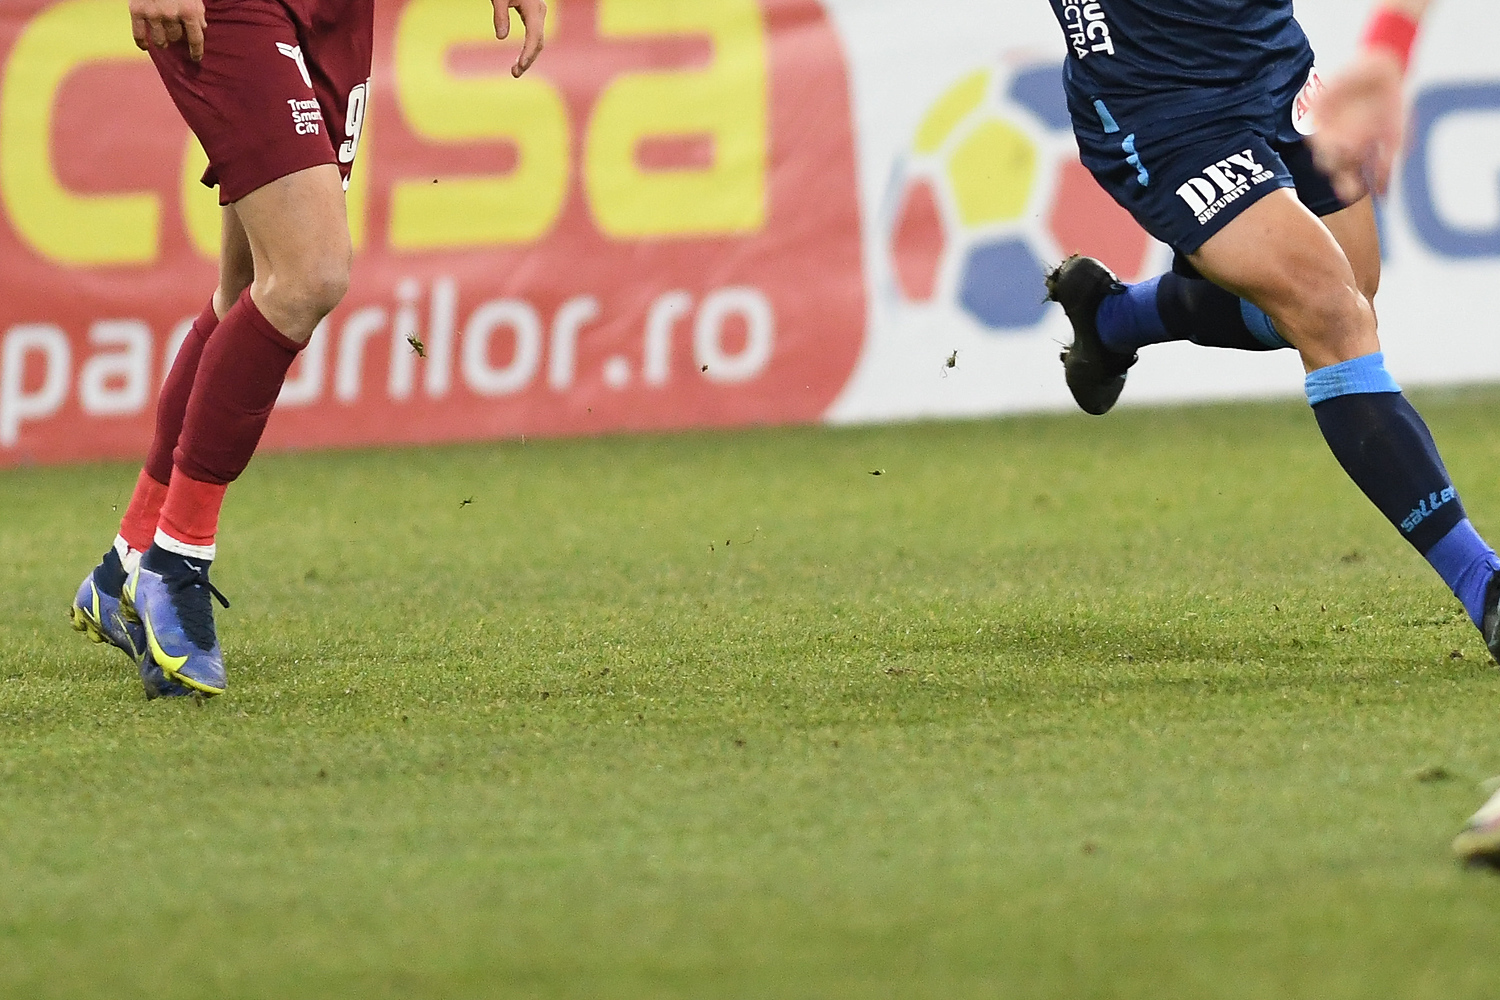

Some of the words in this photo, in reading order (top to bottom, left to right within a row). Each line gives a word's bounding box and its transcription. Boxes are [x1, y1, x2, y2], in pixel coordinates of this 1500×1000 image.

[295, 121, 319, 135] City
[1176, 149, 1264, 217] DEY
[1197, 182, 1251, 226] SECURITY
